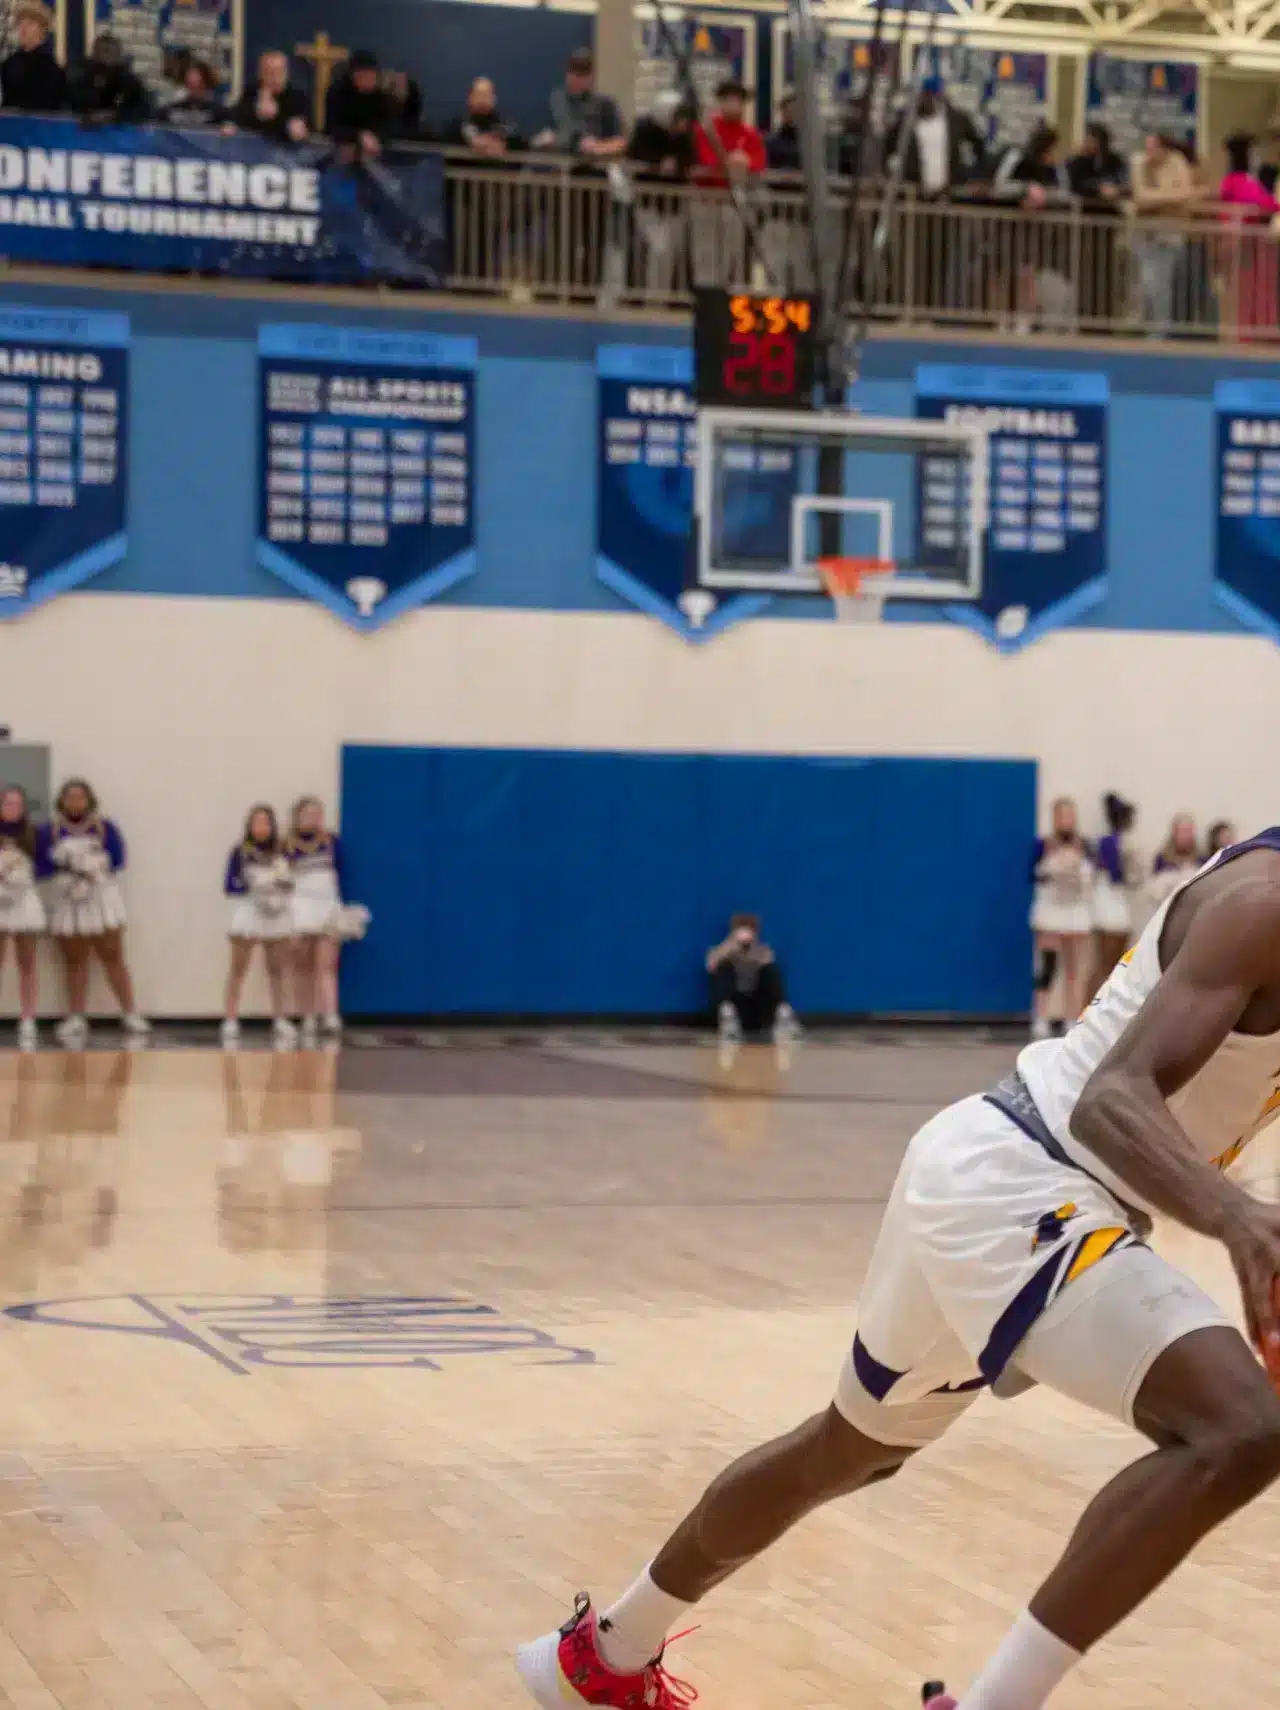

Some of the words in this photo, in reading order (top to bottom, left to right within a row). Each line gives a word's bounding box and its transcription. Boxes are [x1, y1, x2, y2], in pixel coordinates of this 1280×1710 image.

[80, 202, 319, 245] TOURNAMENT
[730, 295, 811, 334] 5:54
[724, 331, 796, 394] 28
